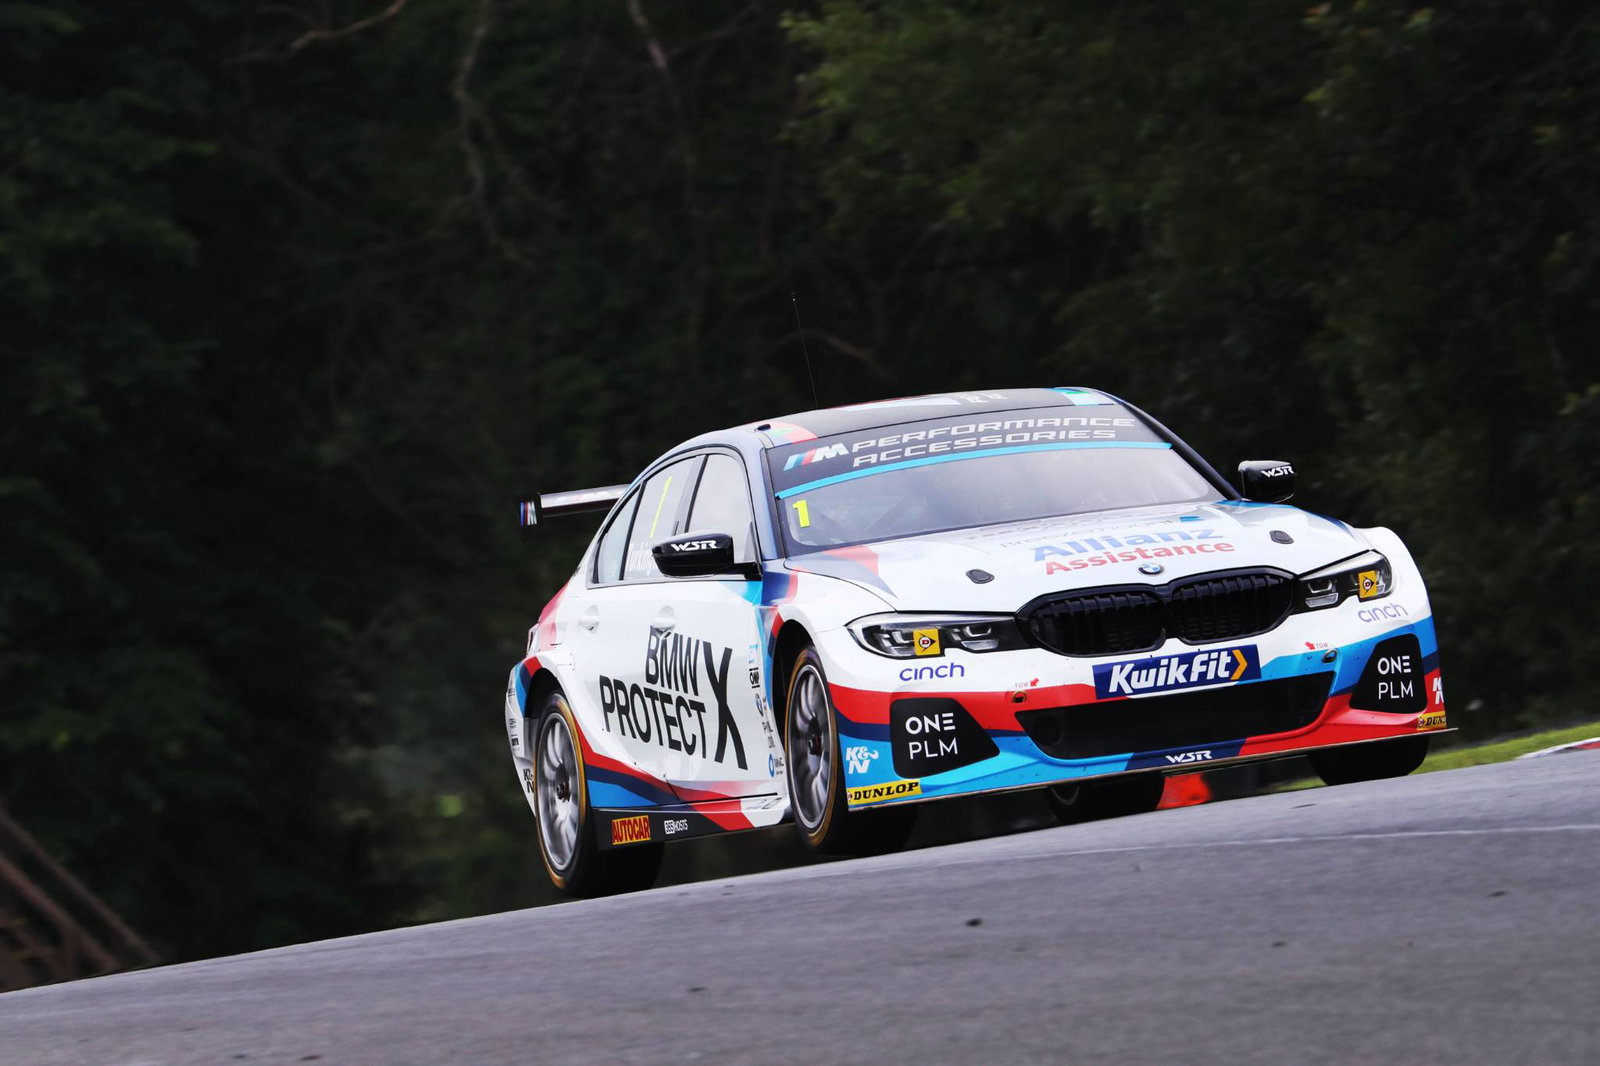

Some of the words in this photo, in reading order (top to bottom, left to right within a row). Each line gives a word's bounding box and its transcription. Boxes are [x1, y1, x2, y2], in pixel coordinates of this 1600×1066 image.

[852, 417, 1135, 453] PERFORMANCE
[852, 429, 1116, 468] ACCESSORIES
[1261, 465, 1294, 478] WSR
[793, 500, 810, 527] 1
[671, 540, 717, 552] WSR
[1033, 528, 1225, 562] Allianz
[1046, 542, 1236, 575] Assistance
[1358, 602, 1409, 623] cinch
[899, 662, 965, 681] cinch
[1377, 655, 1412, 675] ONE
[645, 625, 700, 697] BMW
[703, 641, 748, 770] X
[1378, 680, 1414, 700] PLM
[599, 674, 707, 759] PROTECT
[905, 712, 956, 735] ONE
[908, 737, 958, 760] PLM
[1165, 750, 1212, 764] WSR
[853, 781, 919, 800] DUNLOP
[612, 816, 650, 844] AUTOCAR
